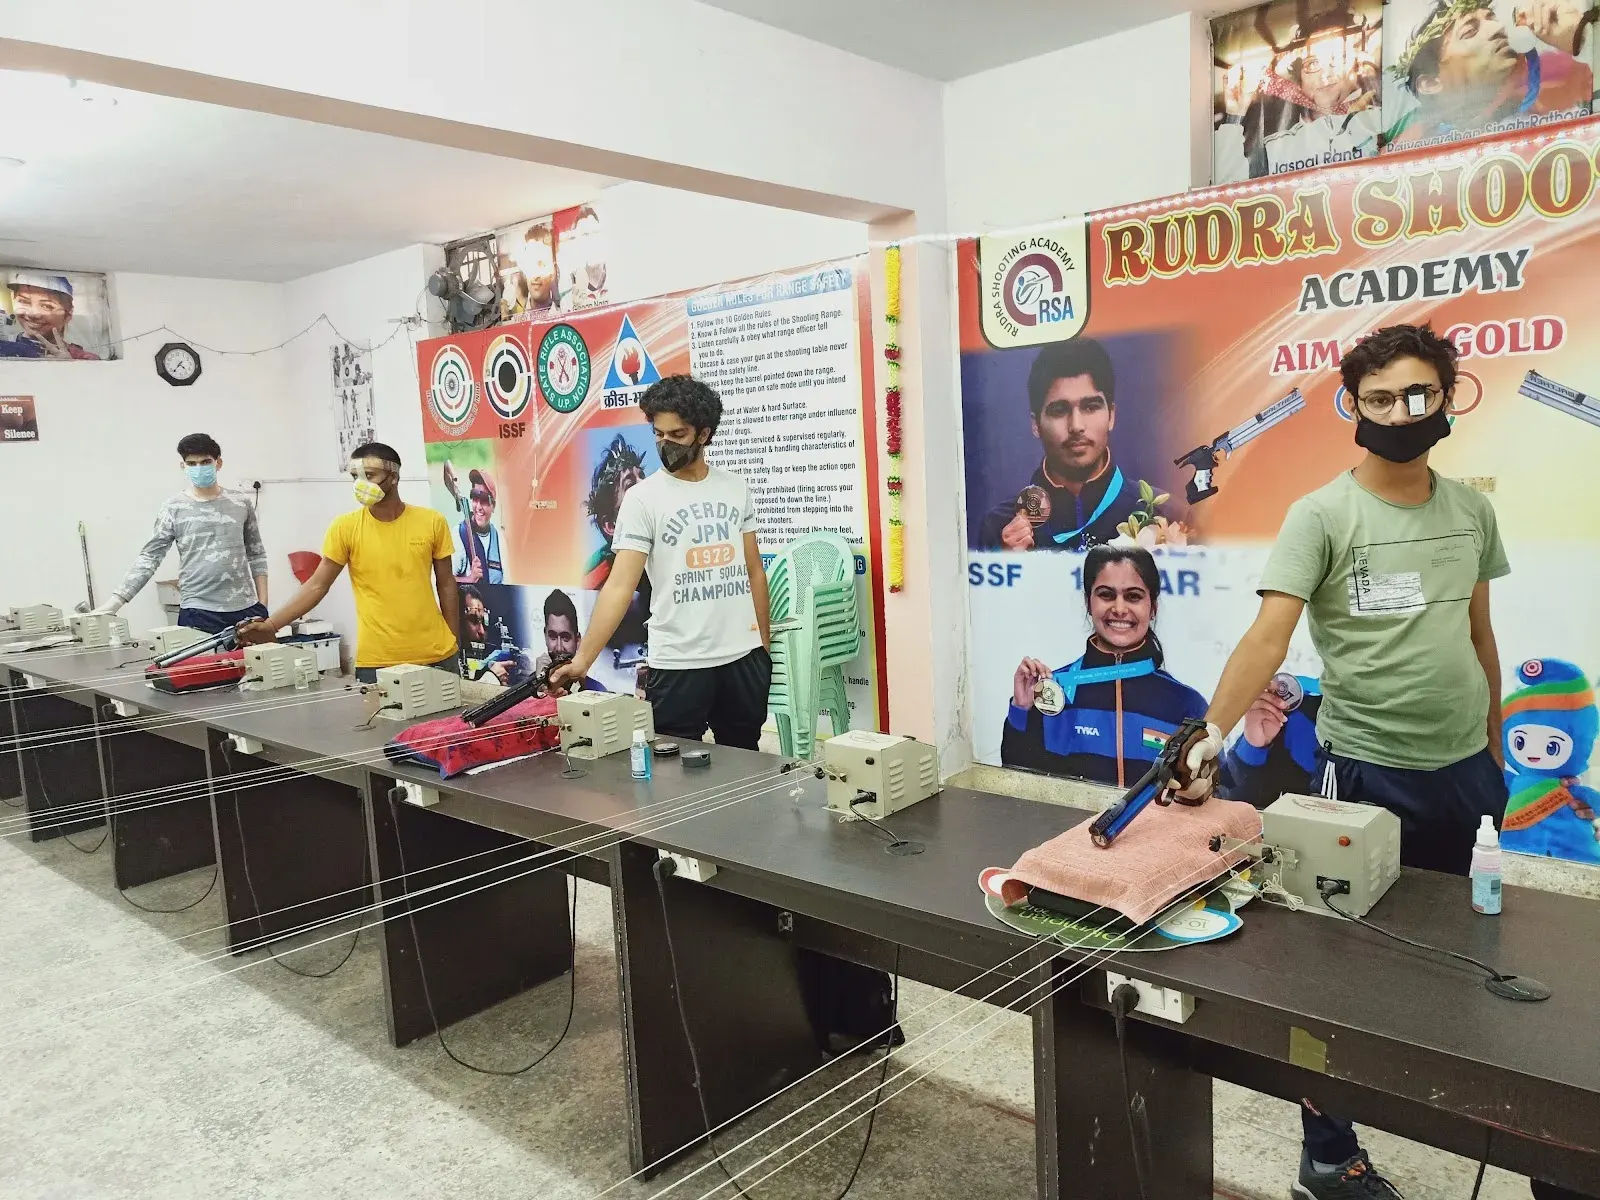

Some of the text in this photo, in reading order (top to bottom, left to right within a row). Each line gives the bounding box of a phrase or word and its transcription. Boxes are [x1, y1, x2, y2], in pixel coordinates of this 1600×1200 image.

[1272, 148, 1363, 175] Jaspal Rana
[1105, 142, 1600, 286] RUDRA SHOO
[777, 279, 807, 297] RANGE
[810, 272, 847, 291] SAFETY
[992, 237, 1075, 337] RUDRA SHOOTING ACADEMY
[1299, 247, 1531, 313] ACADEMY
[1039, 295, 1075, 324] RSA
[697, 319, 713, 328] Follow
[715, 317, 724, 325] the
[726, 315, 733, 324] 10
[734, 313, 753, 322] Golden
[697, 330, 712, 339] Know
[720, 326, 737, 335] Follow
[747, 322, 756, 331] the
[757, 321, 772, 329] rules
[781, 317, 790, 326] the
[792, 312, 819, 324] Shooting
[821, 309, 844, 319] Range.
[698, 340, 714, 349] Listen
[716, 336, 739, 346] carefully
[747, 333, 760, 341] obey
[762, 329, 776, 339] what
[778, 328, 795, 337] range
[796, 325, 816, 334] officer
[818, 322, 828, 331] tell
[1273, 340, 1343, 373] AIM
[1449, 318, 1564, 358] GOLD
[699, 351, 708, 360] you
[700, 360, 719, 369] Uncase
[727, 357, 739, 365] case
[741, 355, 753, 364] your
[755, 353, 766, 363] gun
[774, 351, 784, 359] the
[785, 347, 811, 357] shooting
[812, 344, 828, 354] table
[830, 342, 848, 351] never
[540, 329, 588, 409] STATE RIFLE ASSOCIATION U.P.
[700, 364, 760, 379] behind the safety line.
[721, 366, 836, 387] keep the barrel pointed down the range.
[721, 388, 735, 397] keep
[736, 387, 744, 395] the
[746, 385, 757, 394] gun
[767, 383, 779, 391] safe
[780, 381, 797, 389] mode
[799, 379, 812, 388] until
[813, 378, 825, 387] you
[826, 375, 846, 385] intend
[1, 404, 23, 416] Keep
[742, 415, 764, 424] allowed
[765, 415, 771, 423] to
[773, 413, 788, 422] enter
[789, 412, 807, 421] range
[808, 410, 826, 419] under
[828, 408, 857, 417] influence
[743, 406, 760, 414] Water
[768, 402, 781, 412] hard
[783, 401, 807, 411] Surface.
[4, 429, 36, 439] Silence
[499, 422, 526, 438] ISSF
[725, 438, 738, 446] have
[739, 438, 750, 446] gun
[751, 434, 775, 443] serviced
[783, 432, 815, 442] supervised
[817, 430, 847, 440] regularly.
[735, 427, 752, 436] drugs.
[708, 449, 724, 457] Learn
[725, 448, 734, 456] the
[735, 446, 767, 455] mechanical
[775, 444, 800, 453] handling
[801, 441, 847, 451] characteristics
[848, 440, 855, 448] of
[715, 459, 725, 467] gun
[727, 459, 736, 467] you
[749, 457, 764, 465] using
[743, 466, 752, 474] the
[753, 465, 770, 475] safety
[772, 465, 783, 474] flag
[792, 464, 807, 473] keep
[808, 463, 818, 472] the
[820, 462, 839, 471] action
[839, 462, 856, 471] open
[766, 484, 853, 496] prohibited (firing across your
[755, 494, 831, 505] opposed to down the line.)
[757, 506, 786, 515] prohibited
[787, 505, 801, 514] from
[802, 505, 828, 515] stepping
[830, 505, 842, 513] into
[843, 504, 853, 512] the
[661, 501, 740, 547] SUPERDR
[767, 516, 794, 525] shooters.
[692, 521, 730, 544] JPN
[785, 526, 810, 534] required
[839, 525, 854, 535] feet,
[763, 537, 777, 546] flops
[692, 547, 731, 566] 1972
[675, 569, 713, 586] SPRINT
[967, 562, 1023, 588] SSF
[1358, 551, 1371, 594] NEVADA
[673, 580, 751, 605] CHAMPIONS
[848, 677, 869, 686] handle
[1074, 726, 1101, 737] TYKA
